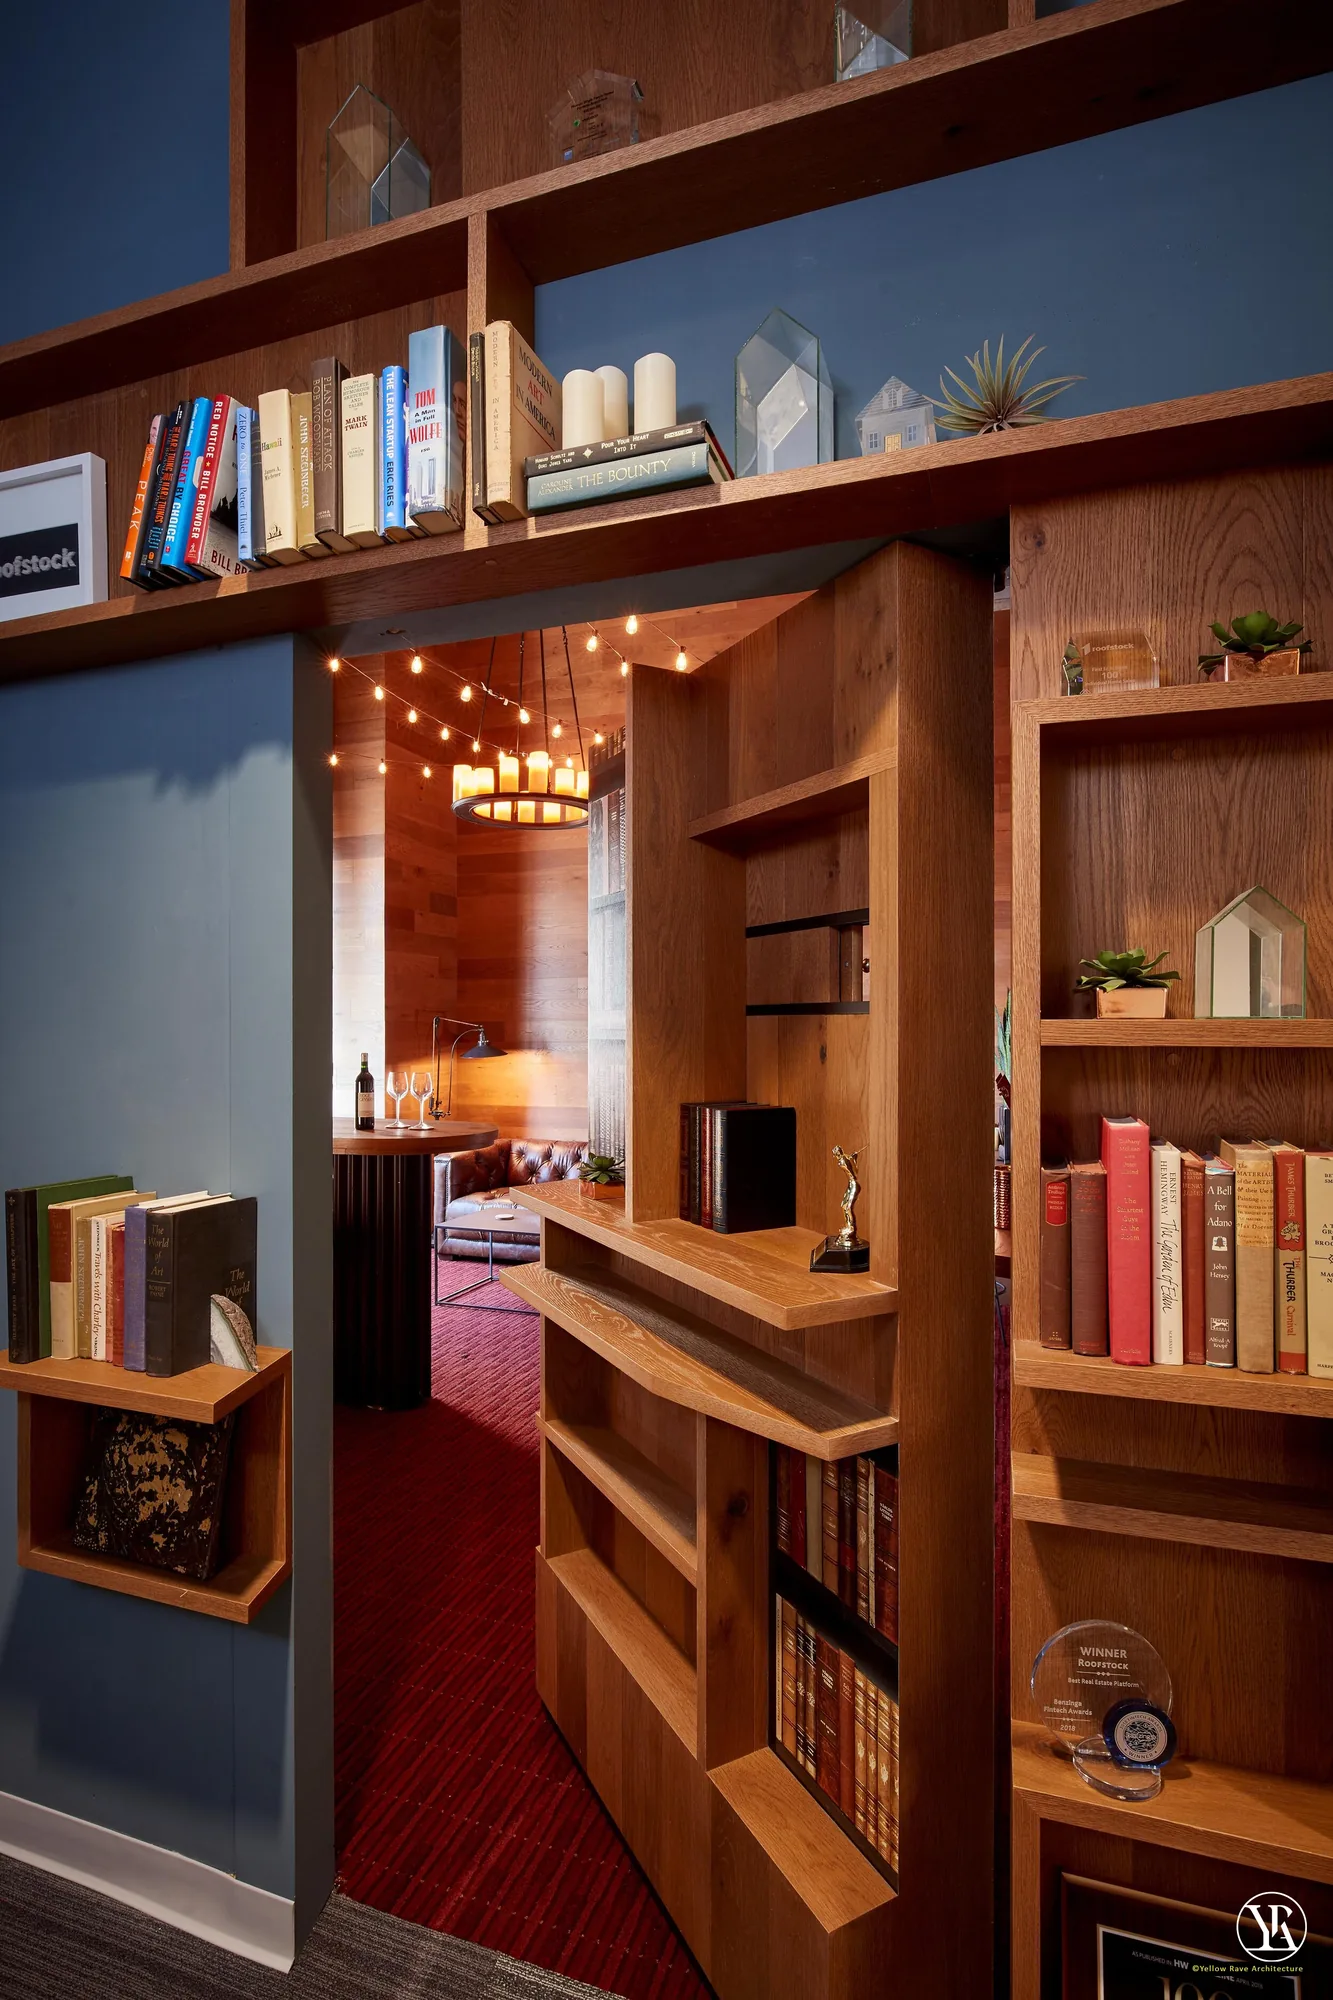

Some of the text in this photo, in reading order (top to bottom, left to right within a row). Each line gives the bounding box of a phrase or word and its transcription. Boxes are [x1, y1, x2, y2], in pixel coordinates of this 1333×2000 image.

[519, 345, 553, 397] MODERN
[344, 382, 369, 391] COMPLETE
[528, 380, 544, 405] ART
[415, 388, 436, 409] TOM
[345, 415, 368, 425] MARK
[516, 383, 556, 441] IN AMERICA
[239, 413, 247, 440] ZERO
[324, 376, 333, 472] PLAN OF ATTACK
[344, 421, 368, 431] TWAIN
[409, 422, 442, 444] WOLFE
[261, 438, 282, 452] Hawaii
[313, 403, 321, 473] WOODWARD
[386, 371, 395, 507] THE LEAN STARTUP ERIC RIES
[632, 433, 650, 442] HEART
[614, 446, 627, 454] INTO
[191, 401, 224, 539] RED NOTICE BILL BROWDER
[300, 415, 309, 508] JOHN STEINBECK
[577, 458, 671, 488] THE BOUNTY
[538, 484, 574, 496] ALEXANDER
[540, 478, 573, 490] CAROLINE
[129, 480, 147, 530] PEAK
[166, 450, 192, 542] GREAT BY CHOICE
[240, 487, 248, 509] Peter
[240, 512, 248, 534] Thiel
[0, 548, 77, 579] ofstock
[211, 550, 230, 572] BILL
[1092, 643, 1134, 652] roofstock
[1160, 1160, 1168, 1216] HEMINGWAY
[1207, 1186, 1232, 1196] A Bell
[1285, 1162, 1296, 1218] JAMES THURBER
[1214, 1200, 1227, 1211] for
[1237, 1195, 1259, 1203] Painting
[152, 1224, 164, 1235] The
[1207, 1216, 1233, 1227] Adano
[148, 1238, 170, 1248] World
[94, 1252, 103, 1280] Travels
[154, 1251, 162, 1263] of
[150, 1266, 164, 1276] Art
[230, 1268, 245, 1282] The
[1156, 1219, 1180, 1314] The Garden of Eden
[1212, 1263, 1228, 1271] John
[1210, 1272, 1230, 1281] Hersey
[94, 1281, 102, 1301] with
[225, 1280, 251, 1298] World
[1283, 1261, 1296, 1336] THURBER Carnival
[92, 1303, 102, 1336] Charley
[1080, 1646, 1128, 1658] WINNER
[1043, 1706, 1093, 1716] Fintech Awards
[1054, 1698, 1082, 1707] Benzinga
[1060, 1724, 1076, 1732] 2018
[1129, 1751, 1154, 1759] WINNER
[1139, 1952, 1166, 1964] PUBLISHED
[1173, 1959, 1190, 1970] HW
